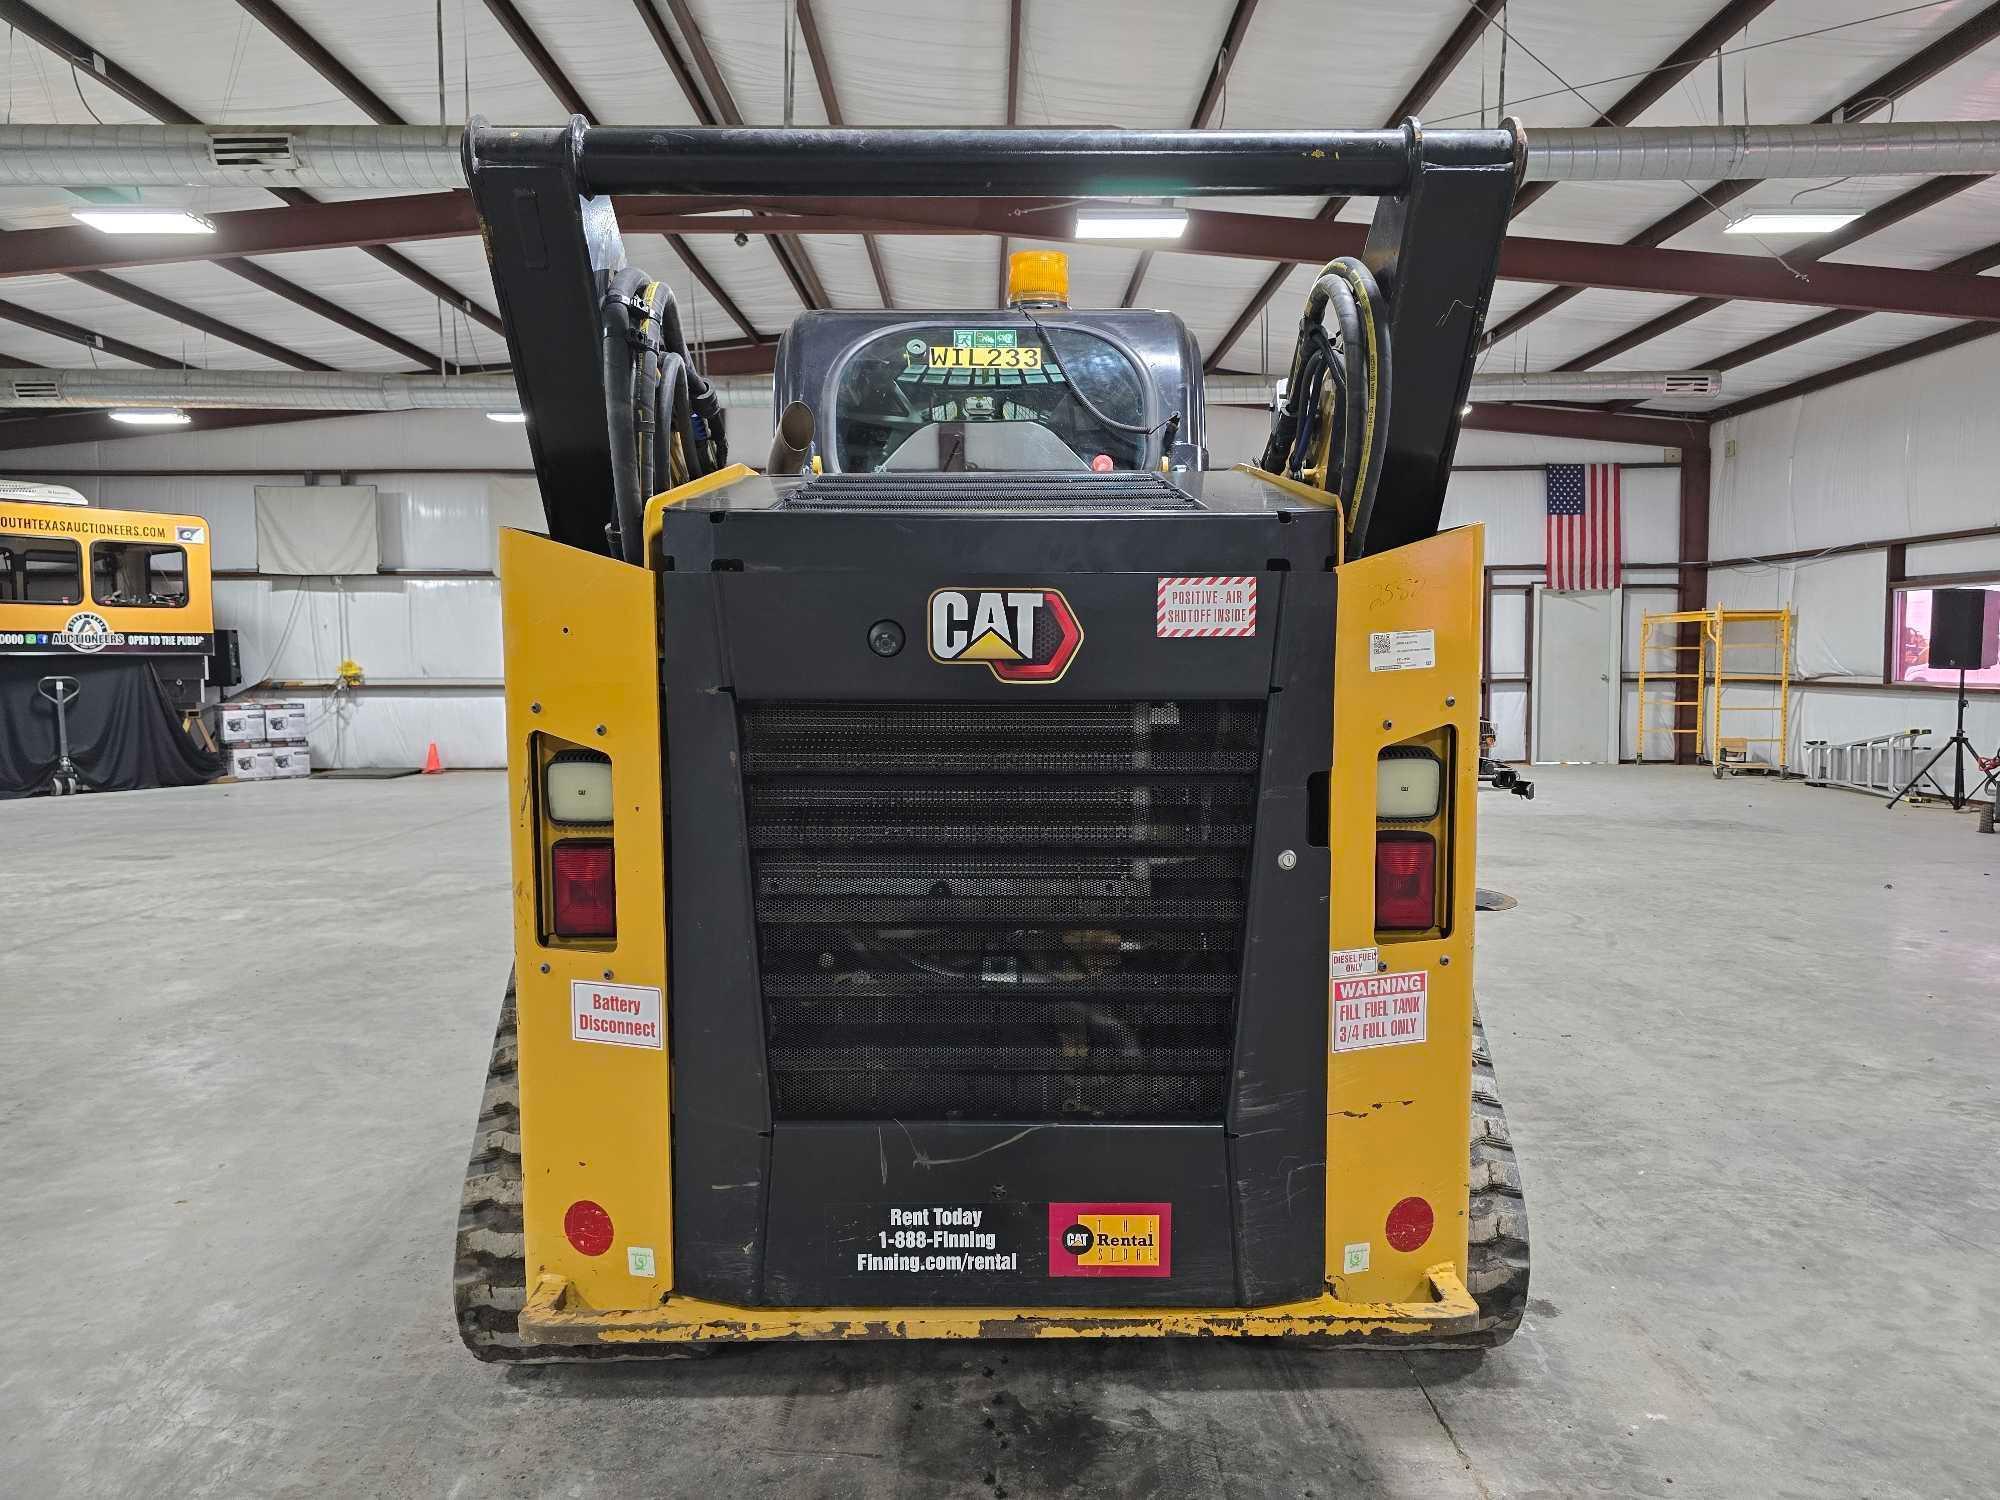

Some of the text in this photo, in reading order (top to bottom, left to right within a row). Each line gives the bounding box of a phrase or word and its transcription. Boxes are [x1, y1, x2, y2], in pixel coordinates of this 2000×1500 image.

[931, 349, 1039, 368] WIL233
[0, 515, 166, 538] OUTHTEXASAUCTIONEERS.COM
[1172, 590, 1218, 605] POSITIVE
[1226, 590, 1242, 604] AIR
[933, 591, 1044, 659] CAT
[1168, 608, 1246, 623] SHUTOFF INSIDE
[52, 632, 125, 646] AUCTIONEERS
[128, 635, 149, 645] OPEN
[149, 635, 161, 645] TO
[161, 635, 177, 646] THE
[1333, 952, 1376, 965] DIESEL FUEL
[1345, 962, 1363, 973] ONLY
[1339, 976, 1421, 999] WARNING
[592, 993, 641, 1016] Battery
[1339, 996, 1421, 1022] FILL FUEL TANK
[579, 1014, 656, 1038] Disconnect
[1339, 1017, 1417, 1045] 3/4 FULL ONLY
[890, 1207, 982, 1228] Rent Today
[878, 1230, 996, 1250] 1-888-Finning
[1066, 1232, 1089, 1247] CAT
[1096, 1233, 1154, 1247] Rental
[857, 1252, 1017, 1273] Finning.com/rental
